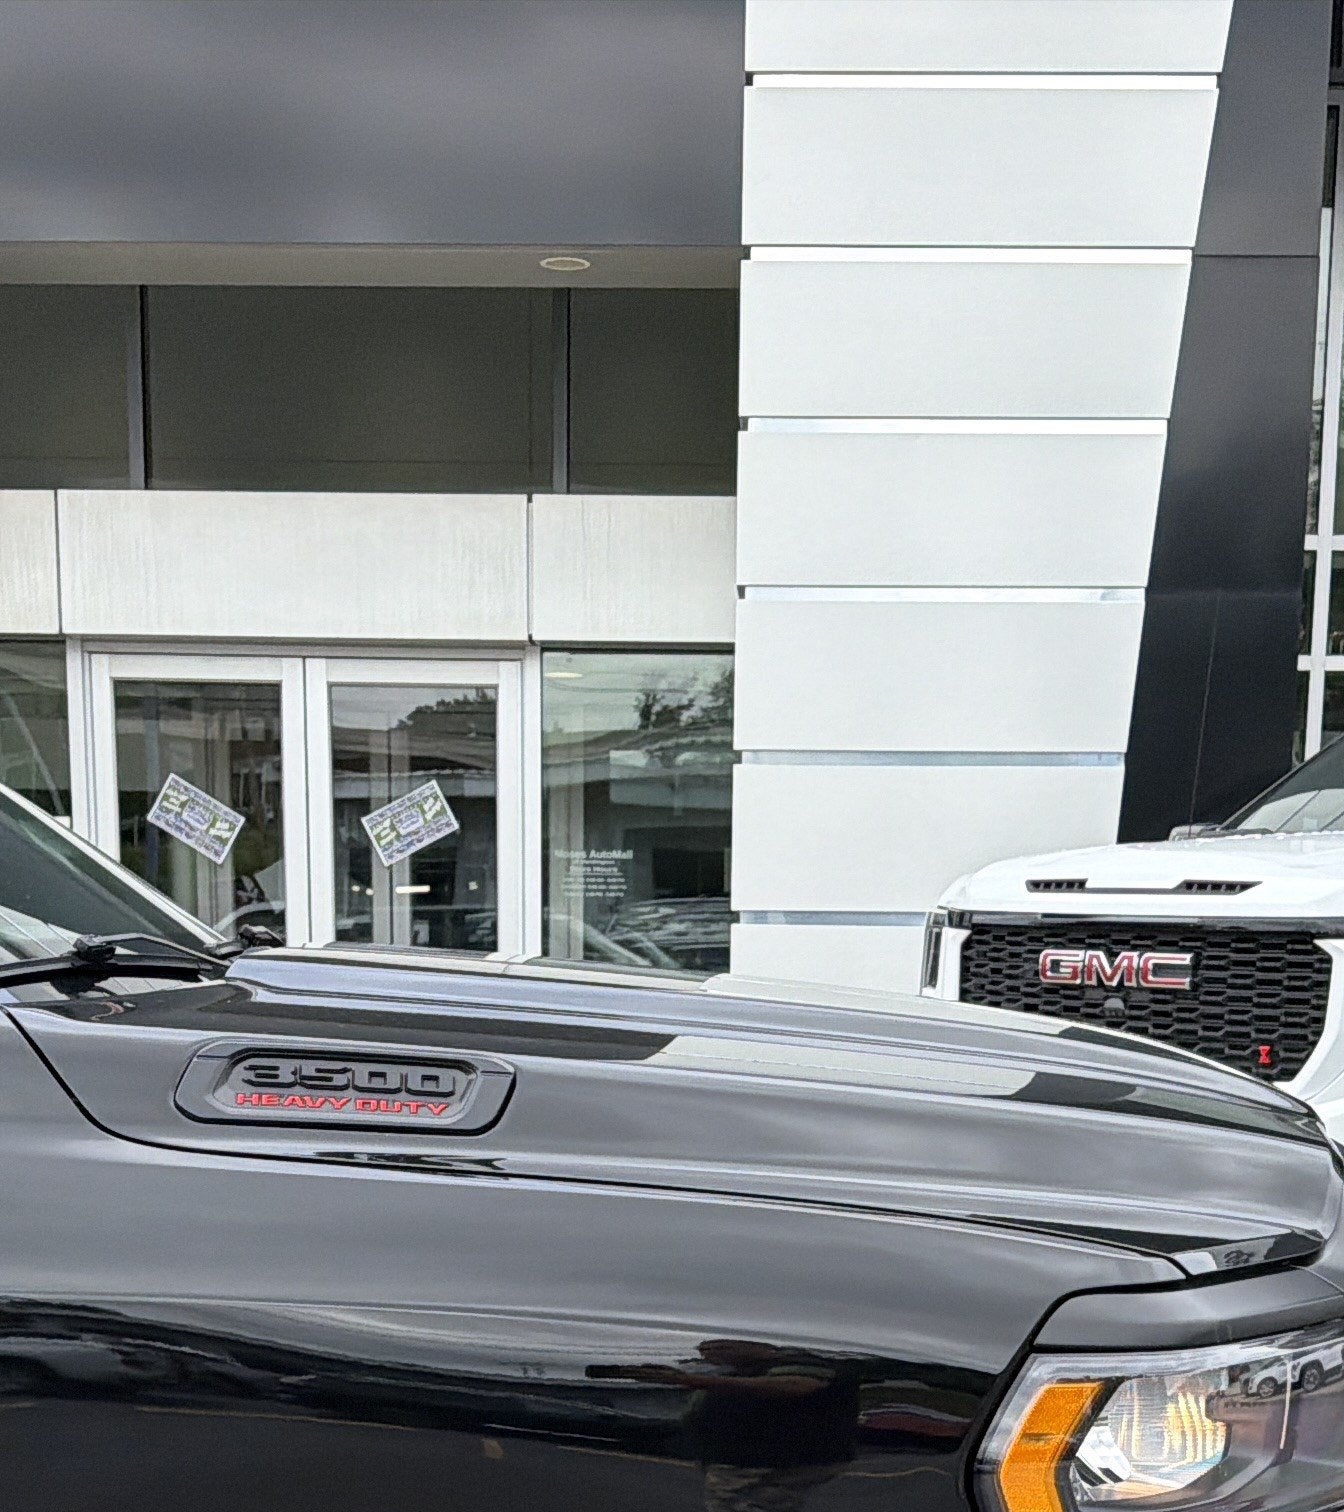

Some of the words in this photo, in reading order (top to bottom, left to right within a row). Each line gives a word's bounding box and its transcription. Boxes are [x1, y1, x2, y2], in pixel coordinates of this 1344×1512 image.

[1038, 949, 1196, 990] GMC
[241, 1061, 457, 1098] 3500
[233, 1092, 352, 1111] HEAVY
[354, 1099, 450, 1116] DUTY
